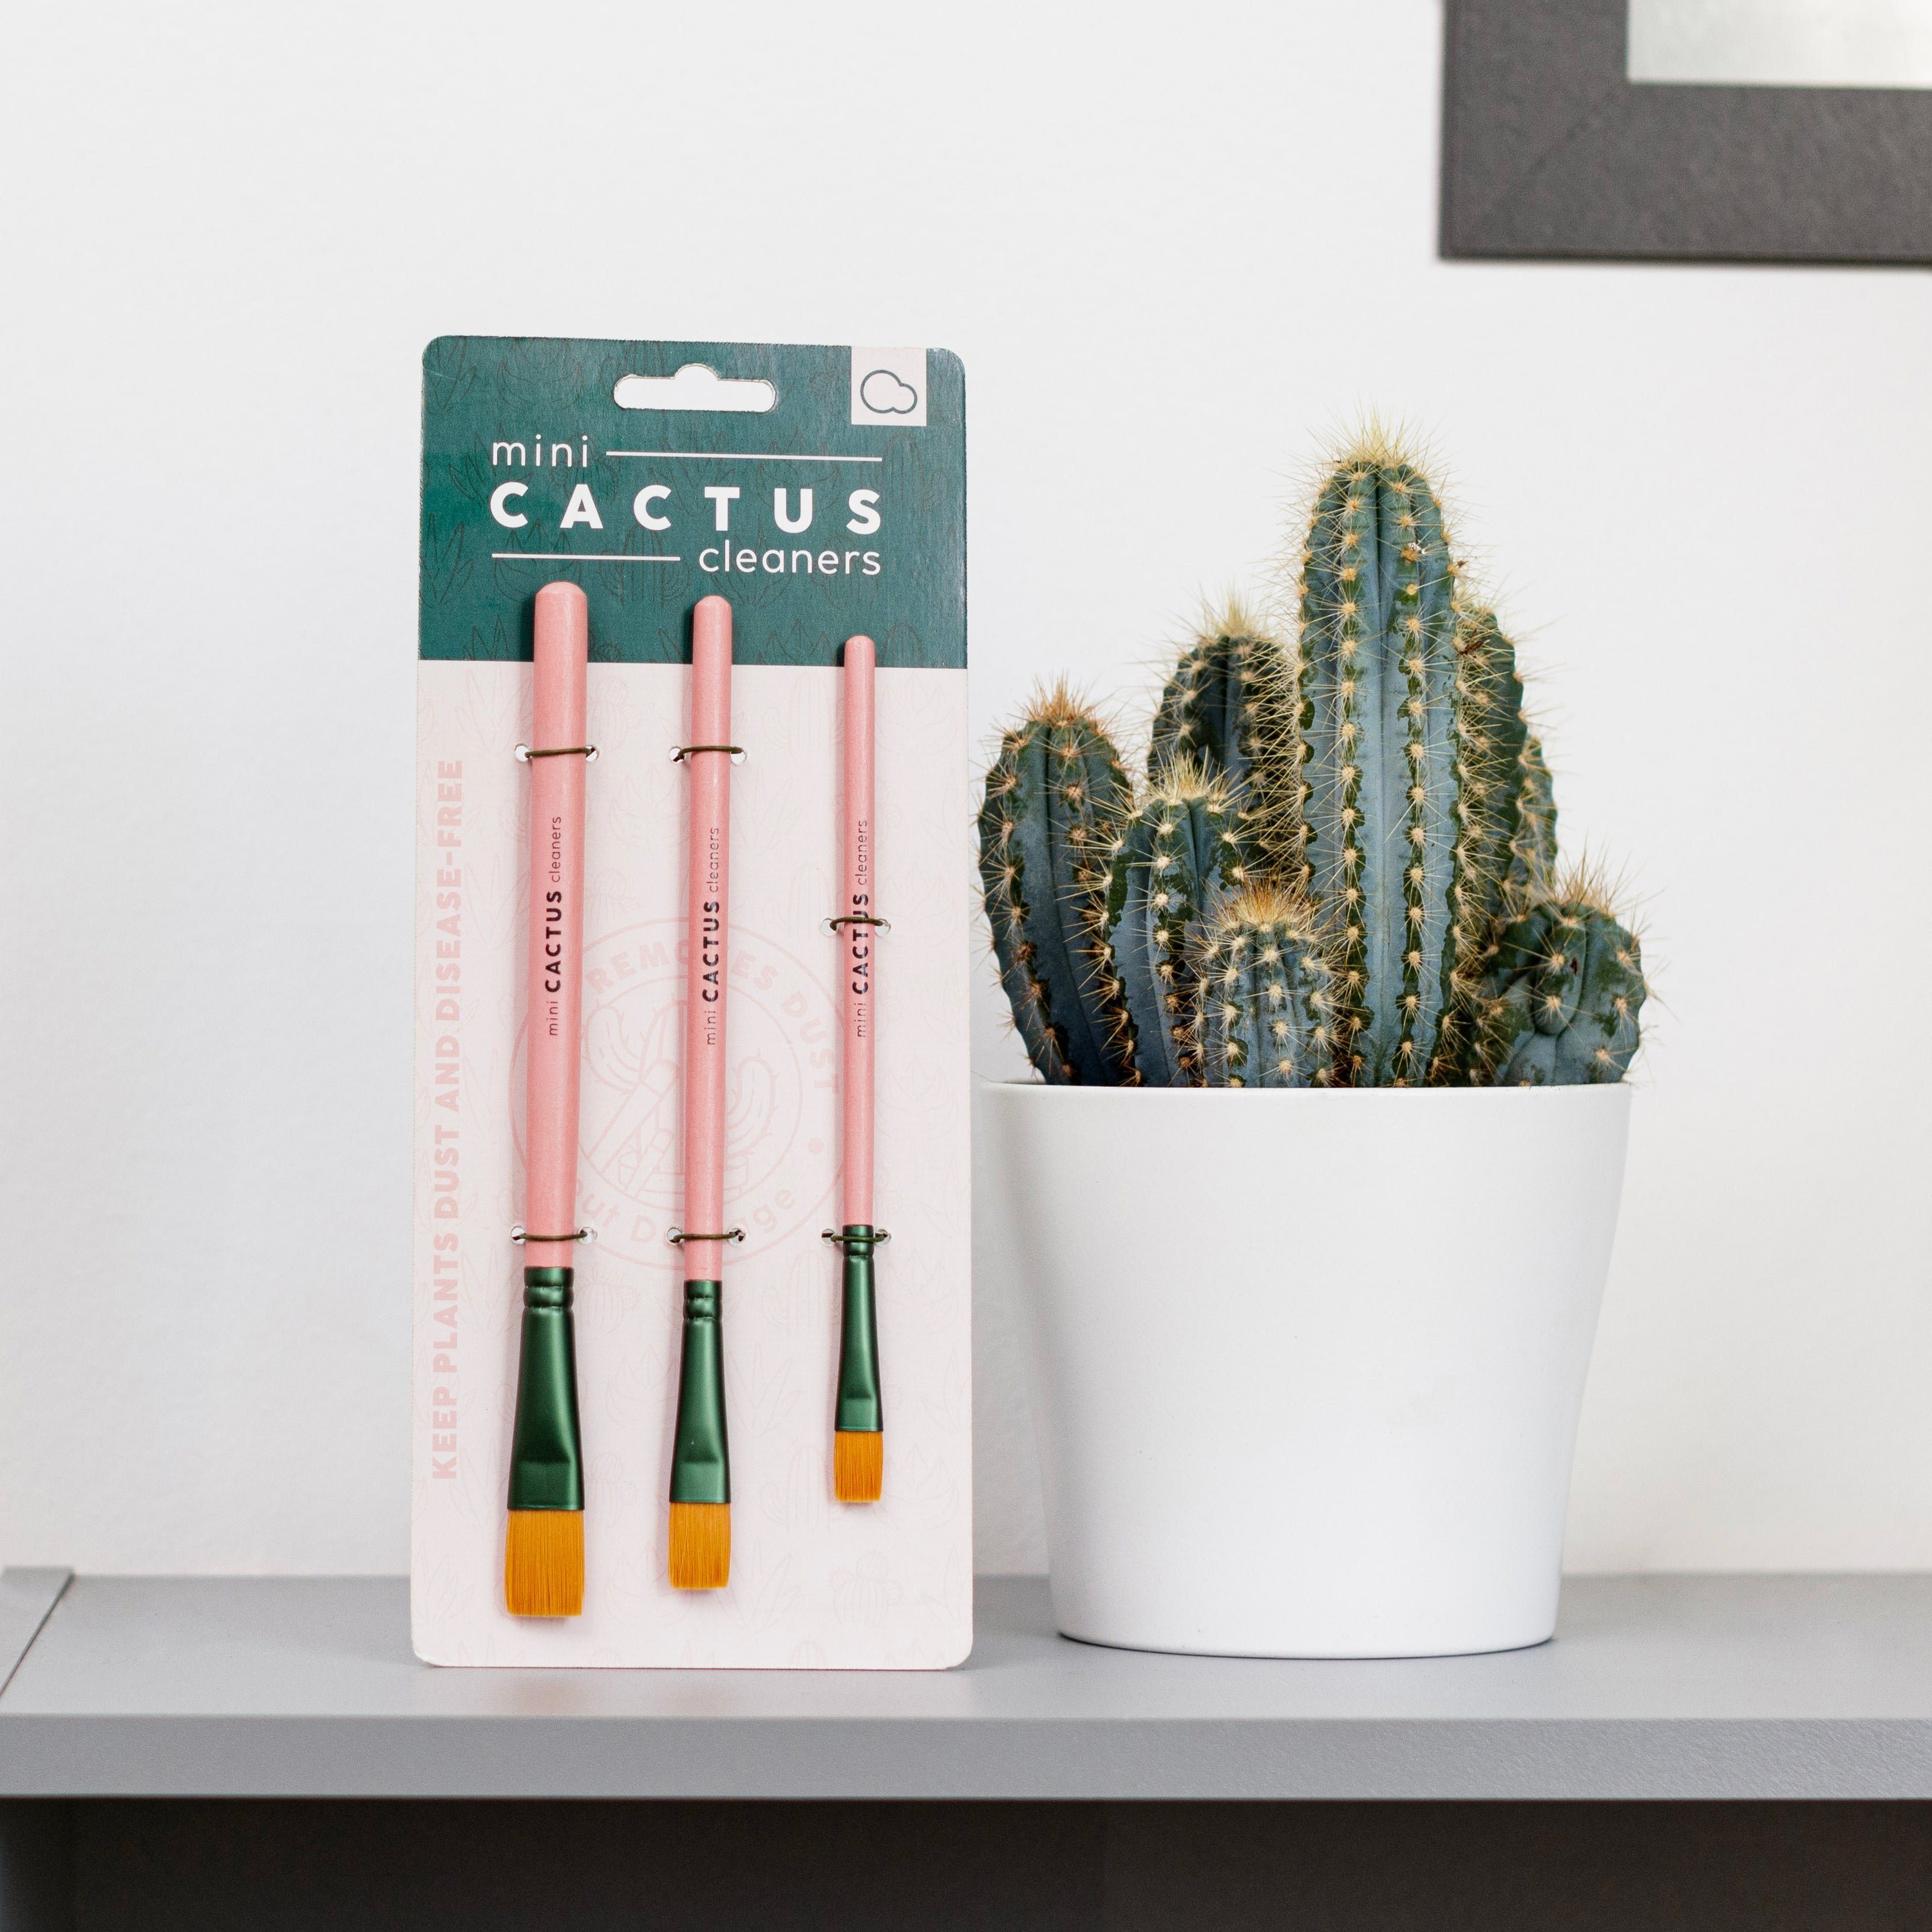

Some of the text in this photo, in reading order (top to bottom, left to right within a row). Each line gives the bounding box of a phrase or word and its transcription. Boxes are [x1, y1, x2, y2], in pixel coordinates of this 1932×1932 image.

[492, 435, 589, 468] mini
[490, 481, 882, 536] CACTUS
[699, 539, 882, 576] cleaners
[855, 820, 867, 886] cleaners
[544, 816, 562, 1036] mini CACTUS cleaners
[701, 828, 720, 1045] mini CACTUS cleaners
[780, 990, 839, 1094] DUST
[854, 1002, 866, 1037] mini
[433, 761, 462, 1479] KEEP PLANTS DUST AND DISEASE-FREE
